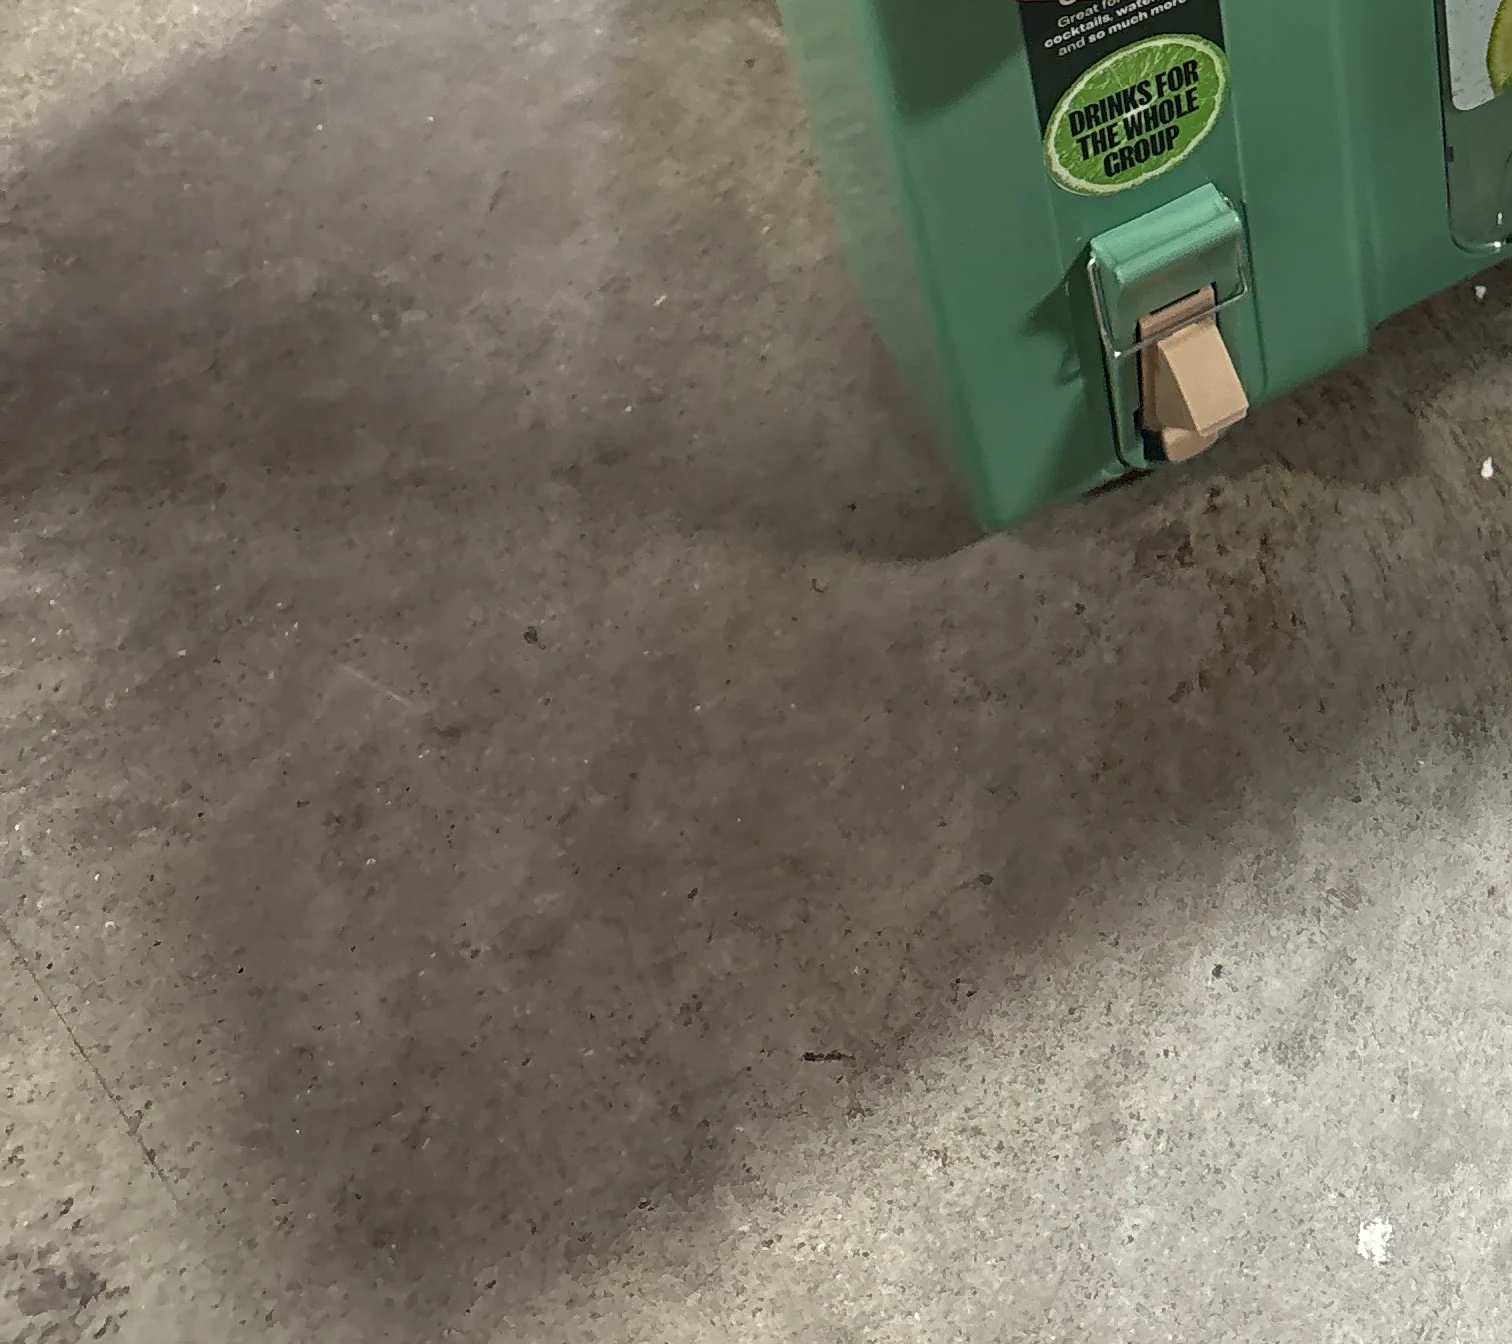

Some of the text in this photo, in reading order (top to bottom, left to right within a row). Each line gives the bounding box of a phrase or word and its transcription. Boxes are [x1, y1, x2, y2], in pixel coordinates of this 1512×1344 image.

[1057, 4, 1099, 28] Great
[1058, 36, 1086, 56] and
[1088, 29, 1106, 44] so
[1108, 11, 1148, 35] much
[1069, 59, 1199, 137] DRINKS FOR
[1077, 87, 1200, 161] THE WHOLE
[1104, 124, 1180, 177] GROUP
